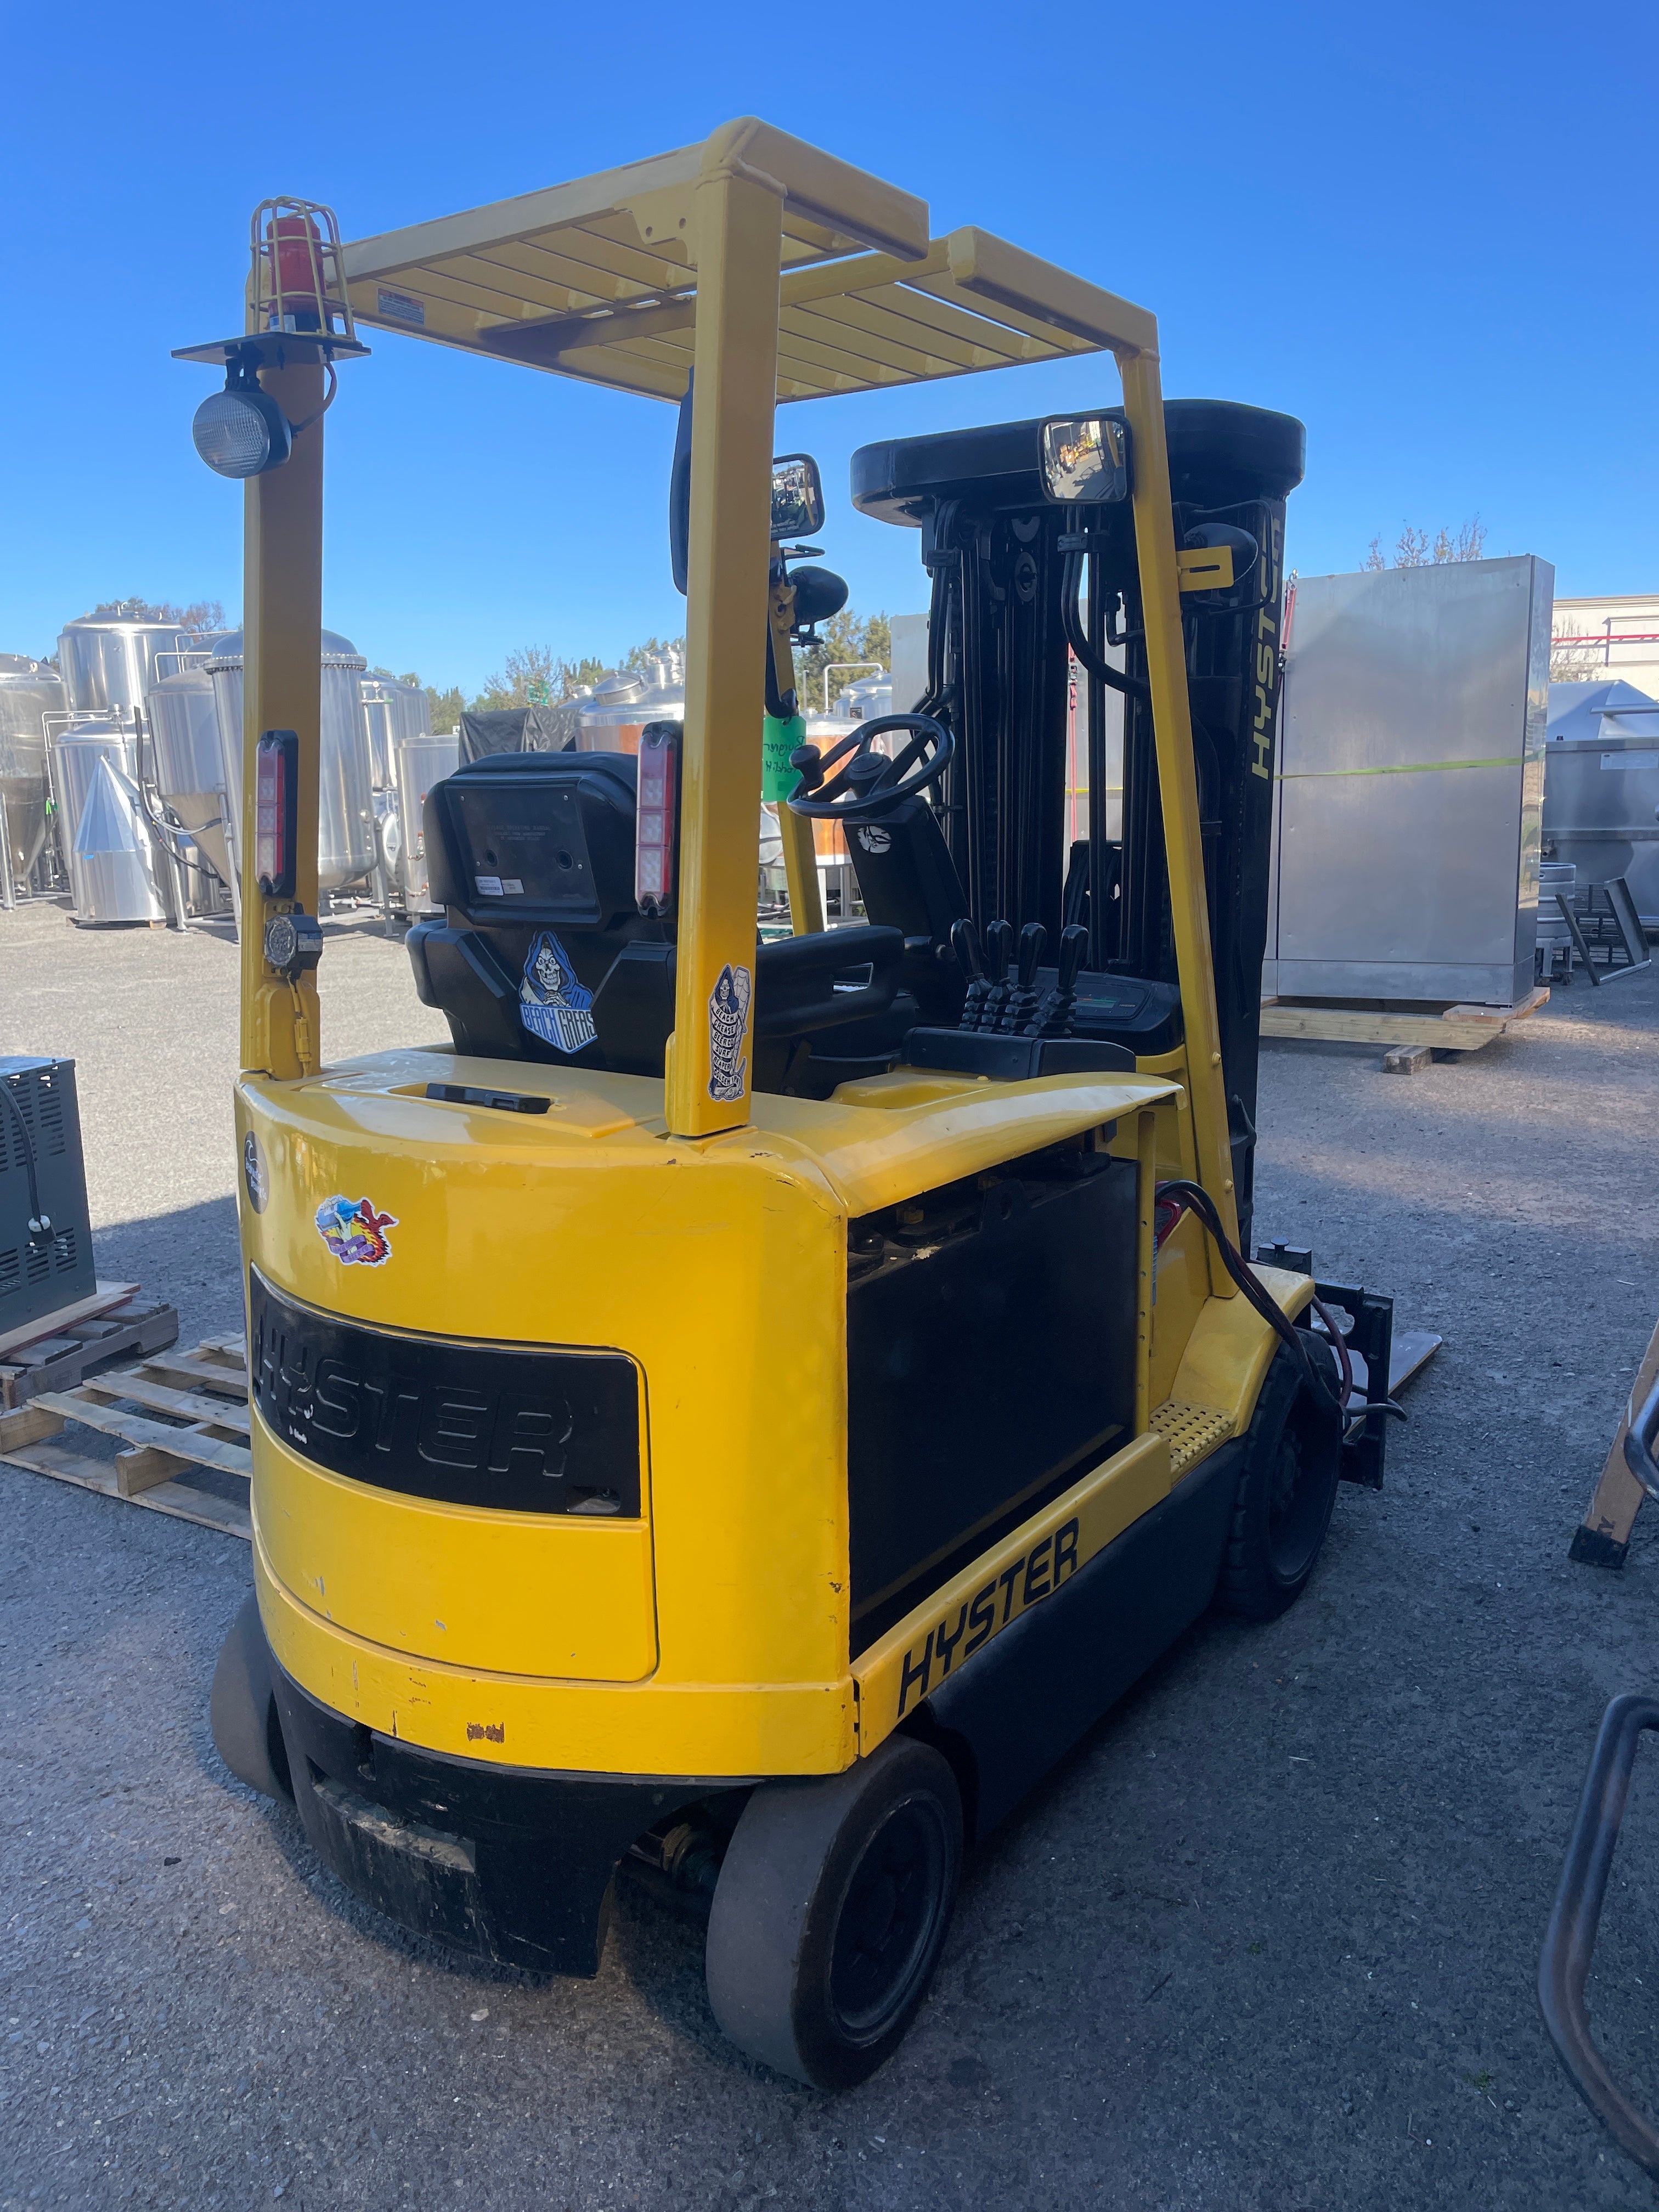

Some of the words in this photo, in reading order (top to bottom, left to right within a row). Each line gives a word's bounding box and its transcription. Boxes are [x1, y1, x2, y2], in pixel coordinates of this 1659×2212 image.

[1251, 517, 1281, 780] HYSTER
[715, 1009, 735, 1022] BEACH
[522, 1006, 564, 1049] BEACH
[557, 1009, 597, 1050] GREAS
[714, 1031, 727, 1046] BEER
[715, 1046, 730, 1057] SURF
[714, 1057, 731, 1070] REAPER
[348, 1250, 362, 1261] BEER
[253, 1314, 573, 1478] HYSTER
[898, 1517, 1079, 1719] HYSTER
